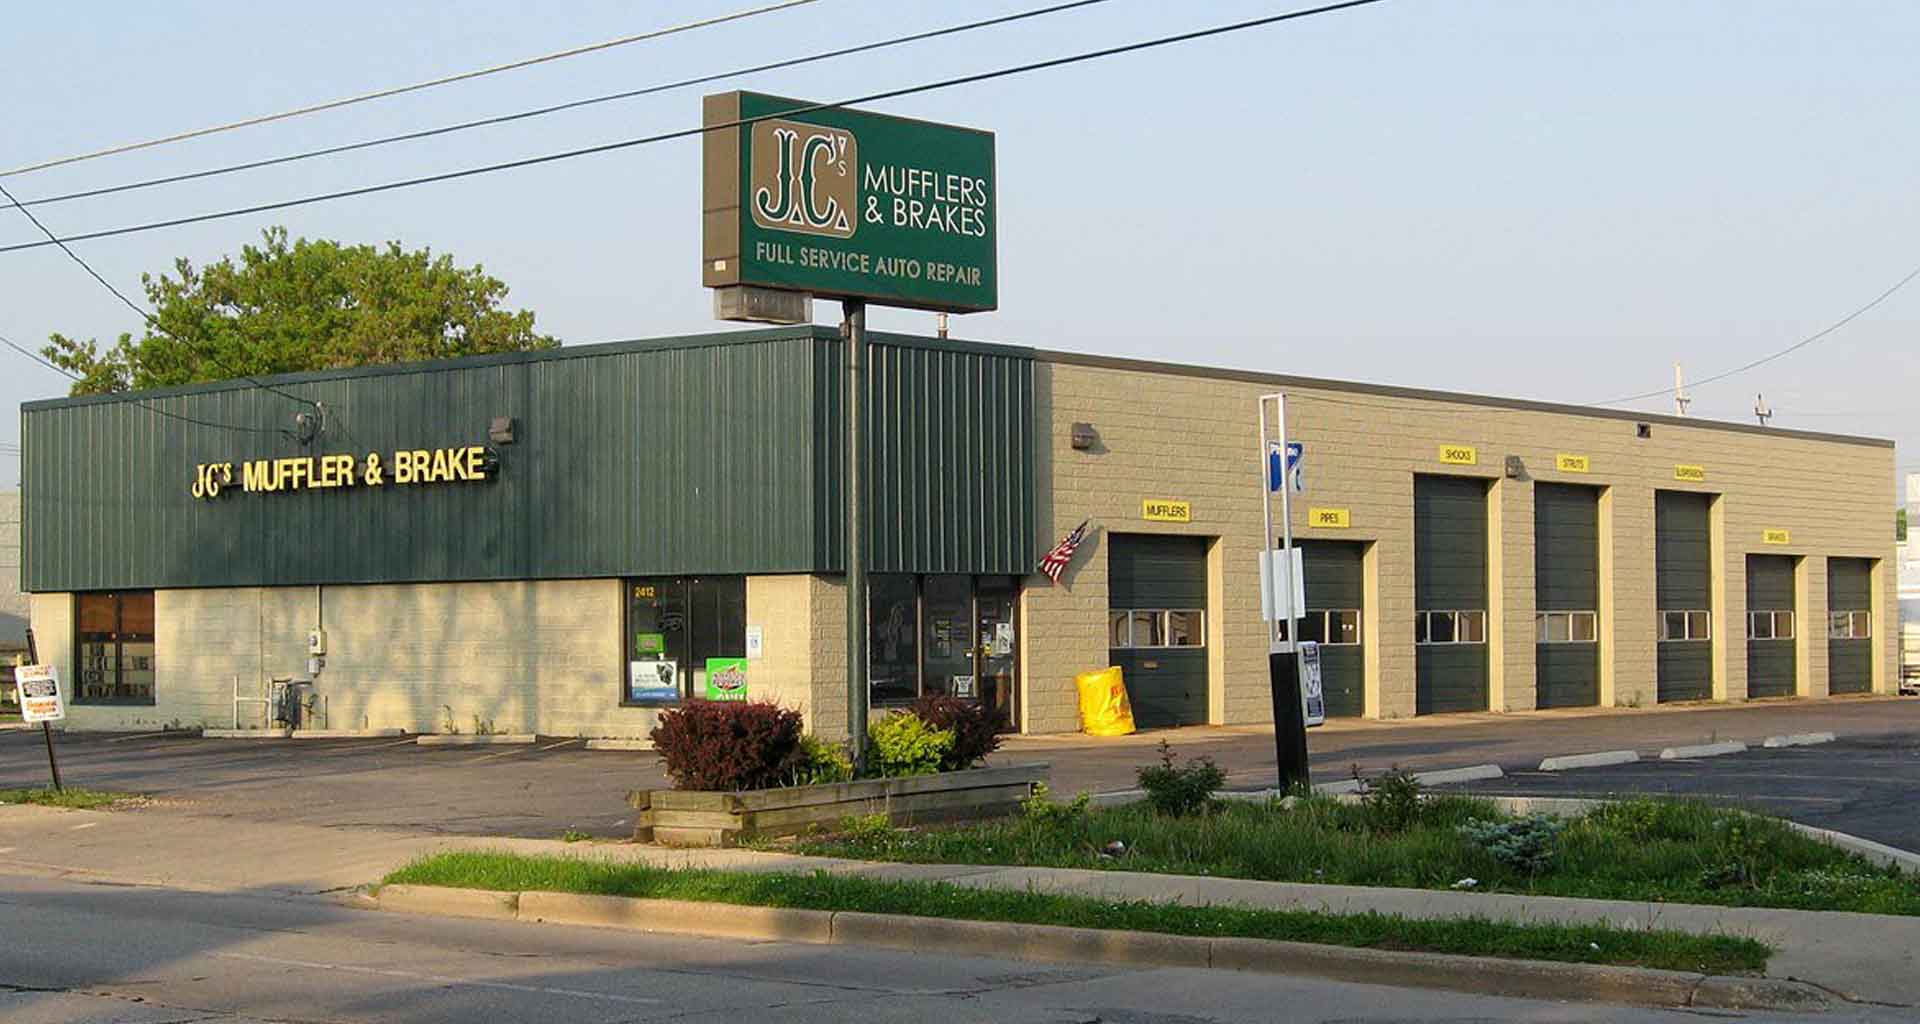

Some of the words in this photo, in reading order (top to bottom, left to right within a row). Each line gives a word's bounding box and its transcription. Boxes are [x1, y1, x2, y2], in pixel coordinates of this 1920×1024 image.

[864, 162, 987, 207] MUFFLERS
[865, 195, 884, 224] &
[894, 197, 986, 237] BRAKES
[756, 242, 794, 264] FULL
[800, 247, 869, 274] SERVICE
[875, 258, 920, 279] AUTO
[926, 262, 981, 286] REPAIR
[1446, 449, 1471, 460] SHOCKS
[242, 454, 354, 492] MUFFLER
[365, 452, 383, 487] &
[394, 446, 485, 484] BRAKE
[1146, 504, 1186, 517] MUFFLERS
[1319, 512, 1338, 523] PIPES
[634, 586, 656, 599] 2412
